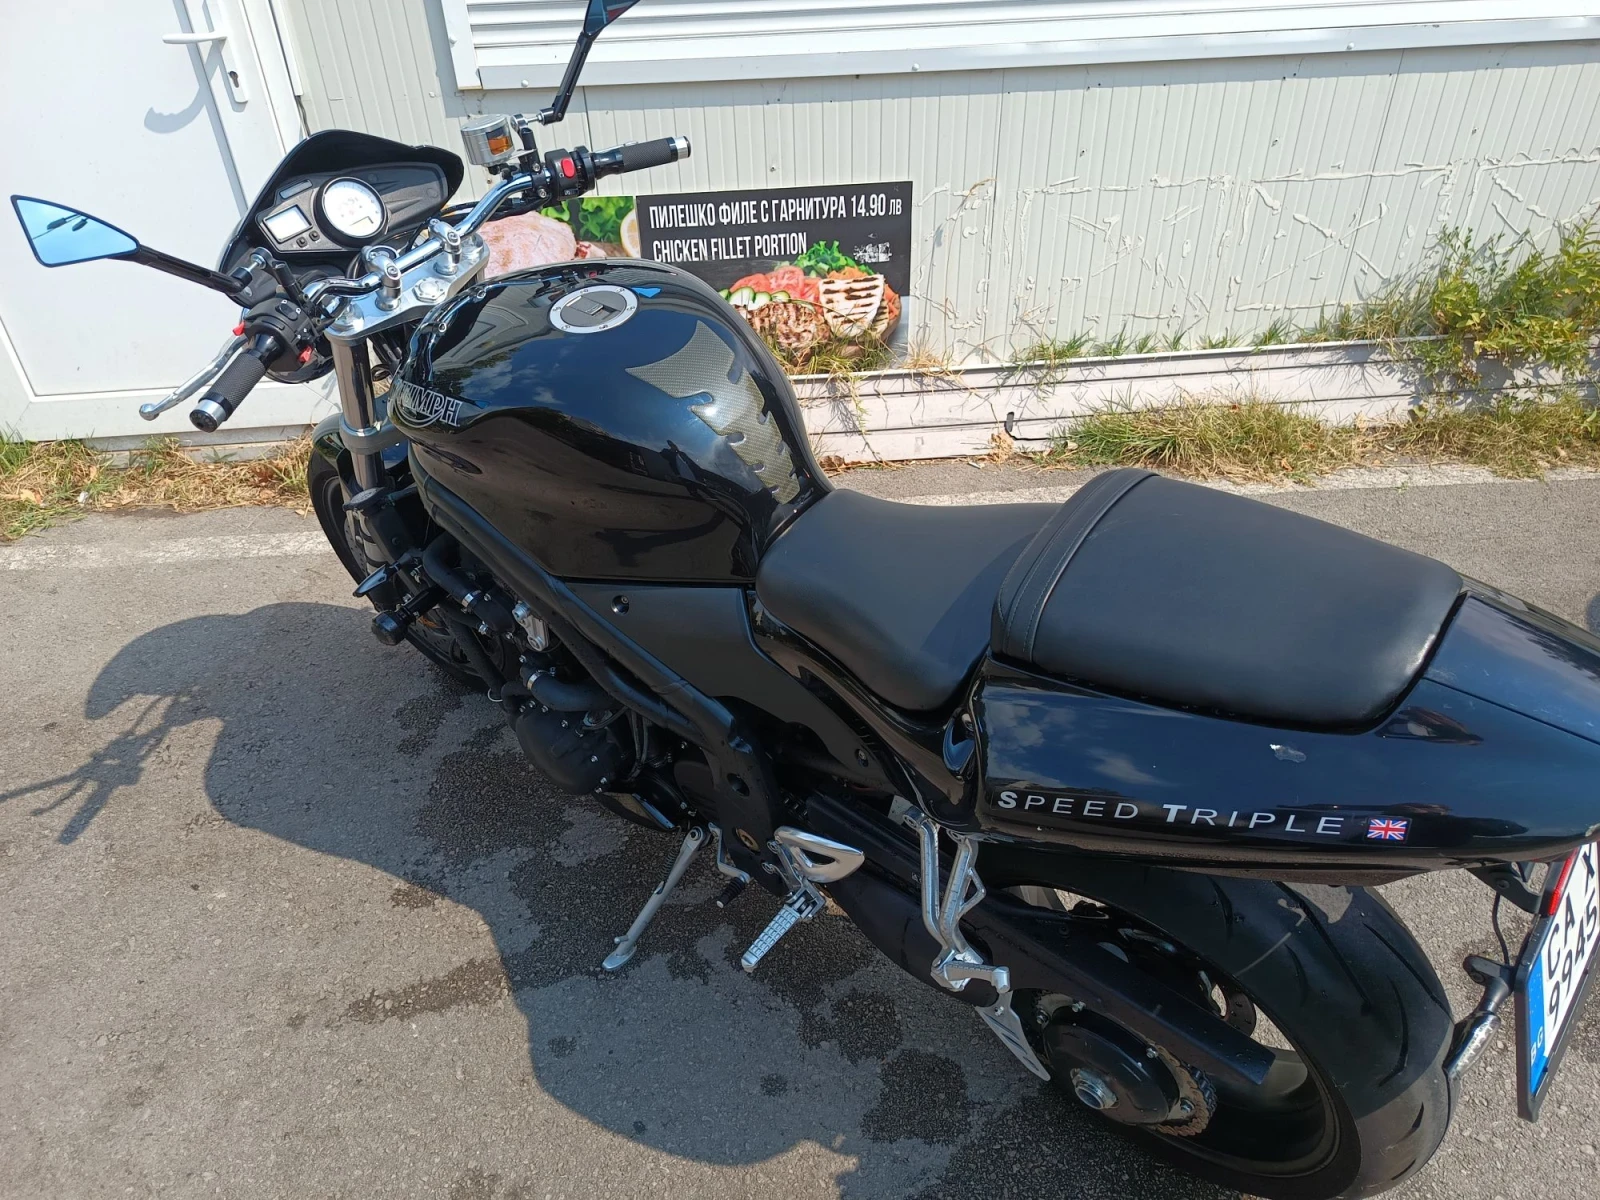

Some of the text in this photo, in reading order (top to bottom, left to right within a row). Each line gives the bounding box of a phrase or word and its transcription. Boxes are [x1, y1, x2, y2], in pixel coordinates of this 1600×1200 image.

[649, 202, 716, 229] ПИЛЕШКО
[718, 200, 758, 226] ФИЛЕ
[771, 195, 847, 222] ГАРНИТУРА
[851, 193, 886, 218] 14.90
[653, 232, 807, 262] CHICKEN FILLET PORTION
[998, 791, 1344, 835] SPEED TRIPLE
[1547, 892, 1575, 981] CA
[1547, 887, 1598, 1031] 9945
[1530, 1025, 1544, 1068] BG
